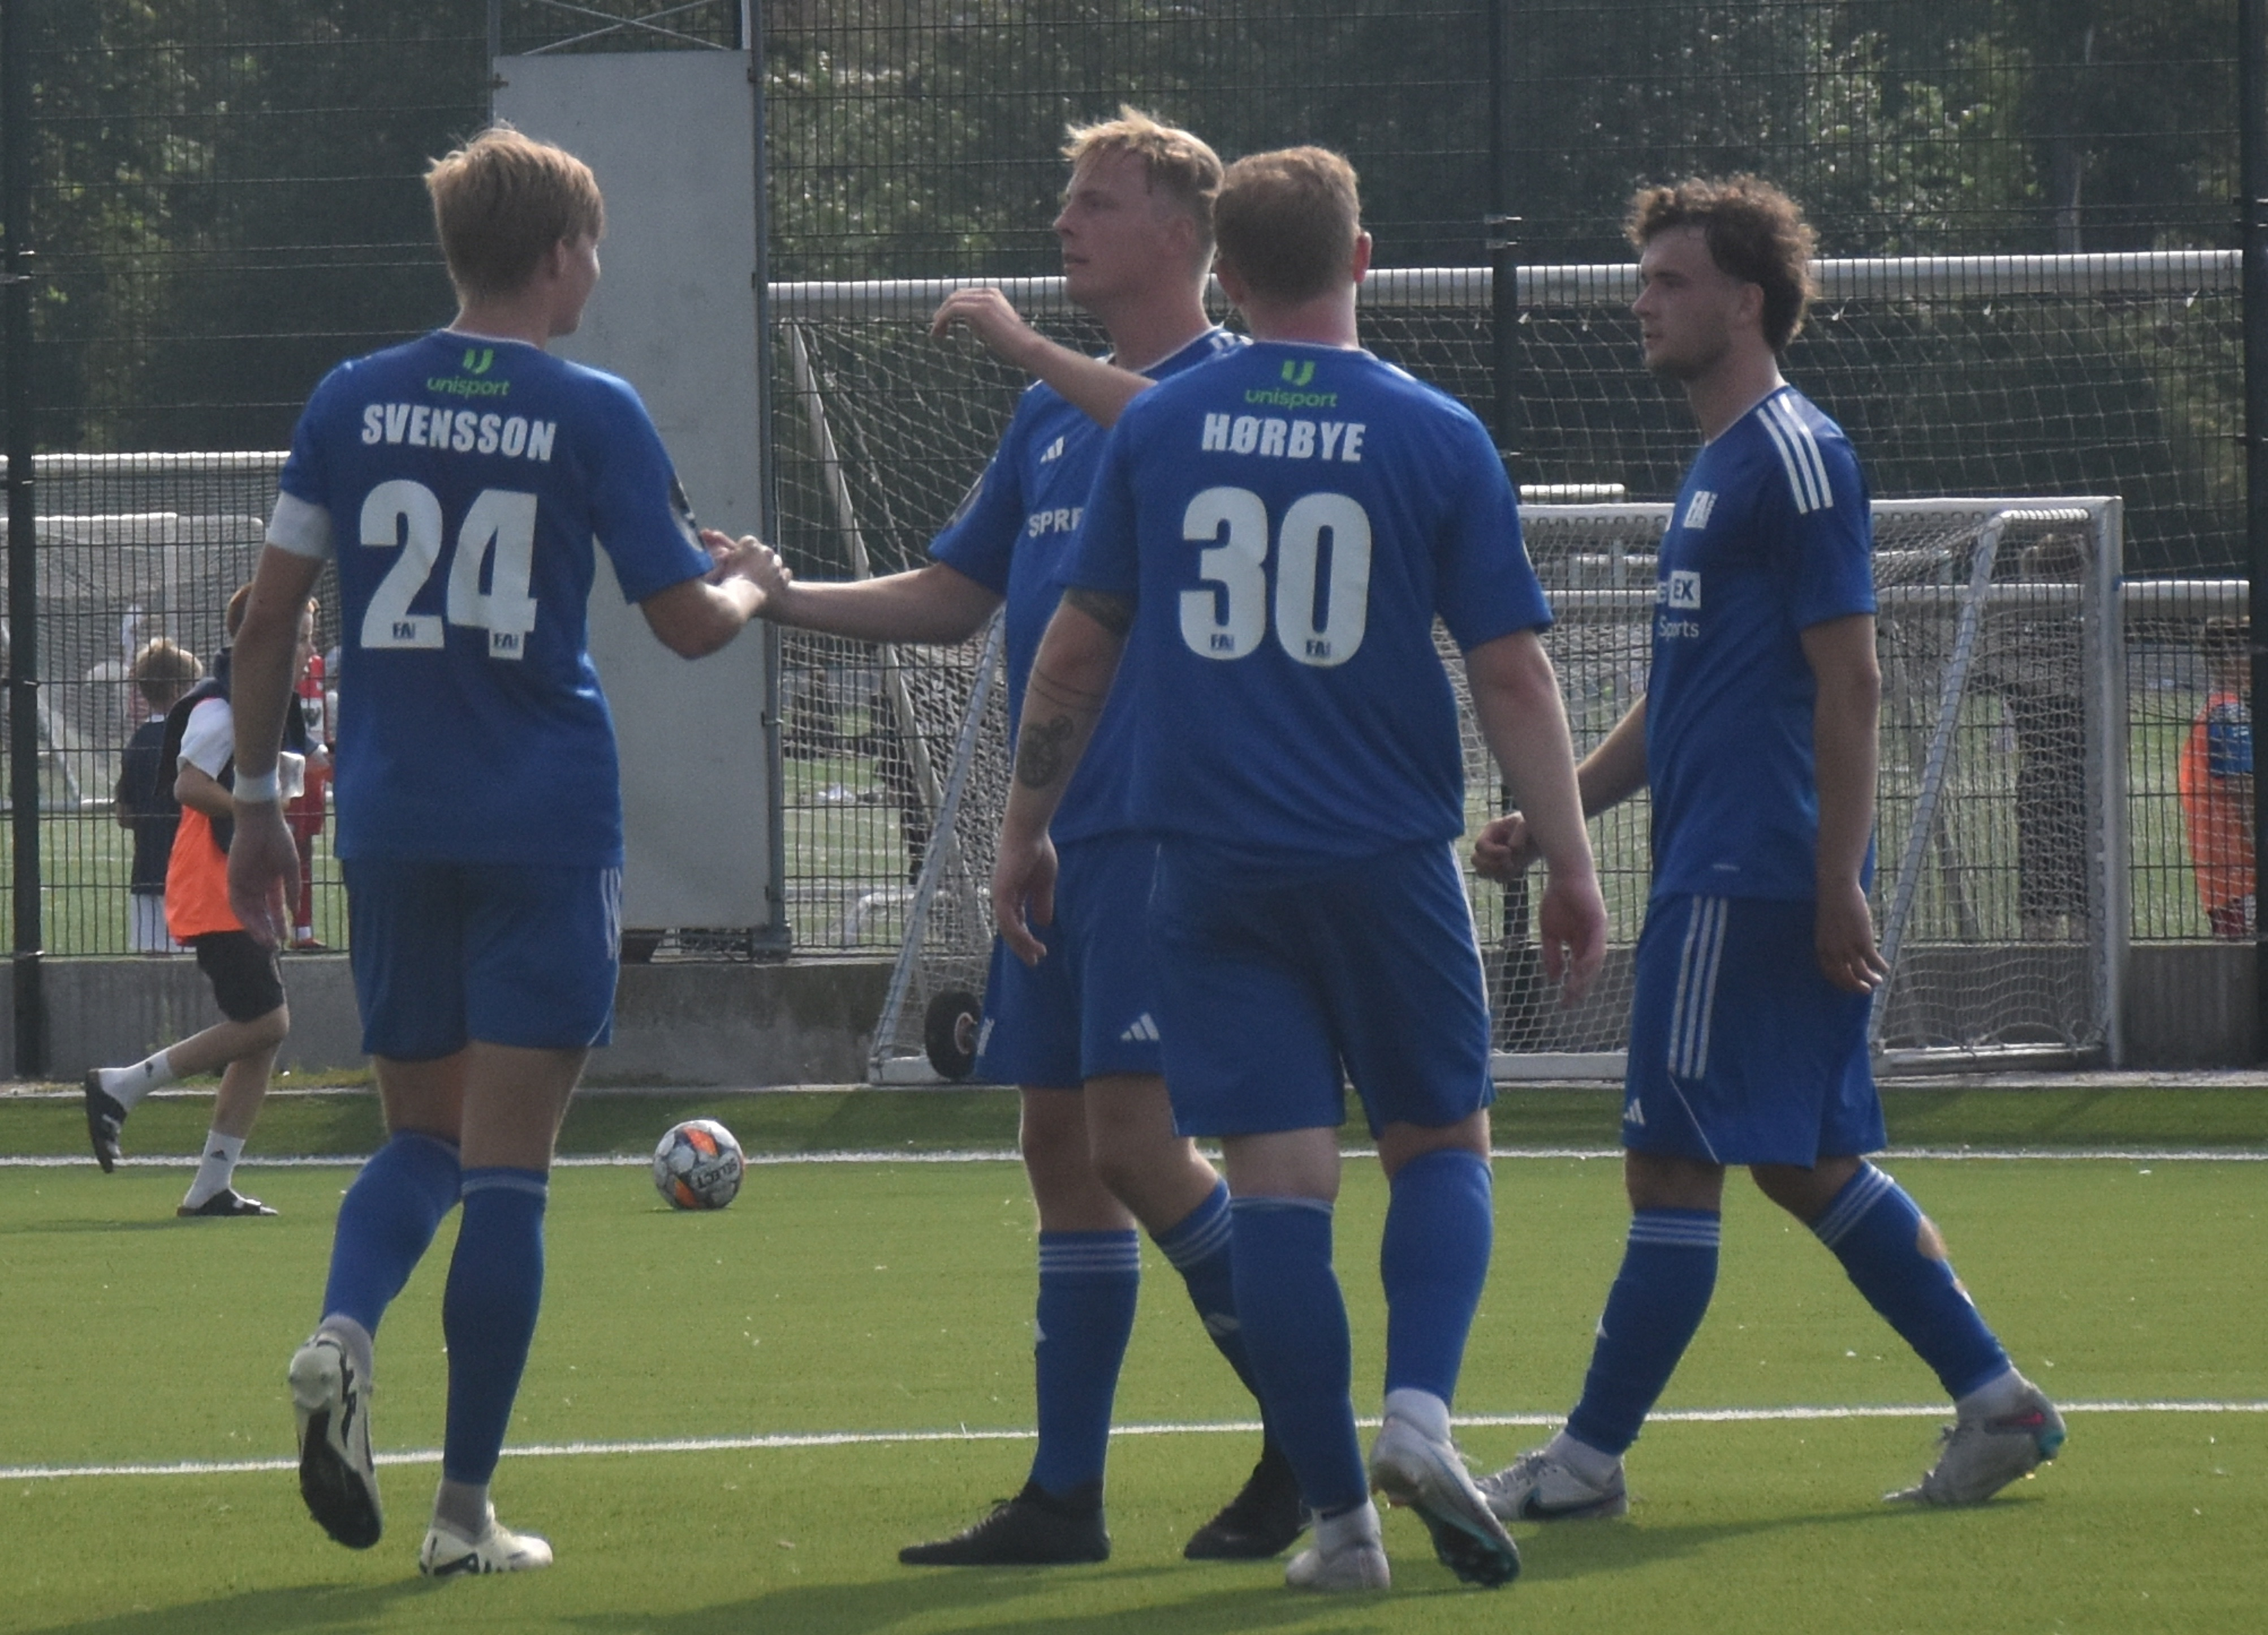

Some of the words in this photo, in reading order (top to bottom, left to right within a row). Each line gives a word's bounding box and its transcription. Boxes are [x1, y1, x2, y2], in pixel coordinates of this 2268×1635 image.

[428, 376, 510, 399] unisport
[1245, 388, 1338, 410] unisport
[361, 403, 556, 461] SVENSSON
[1202, 413, 1366, 462] HØRBYE
[360, 480, 538, 660] 24
[1180, 487, 1372, 667] 30
